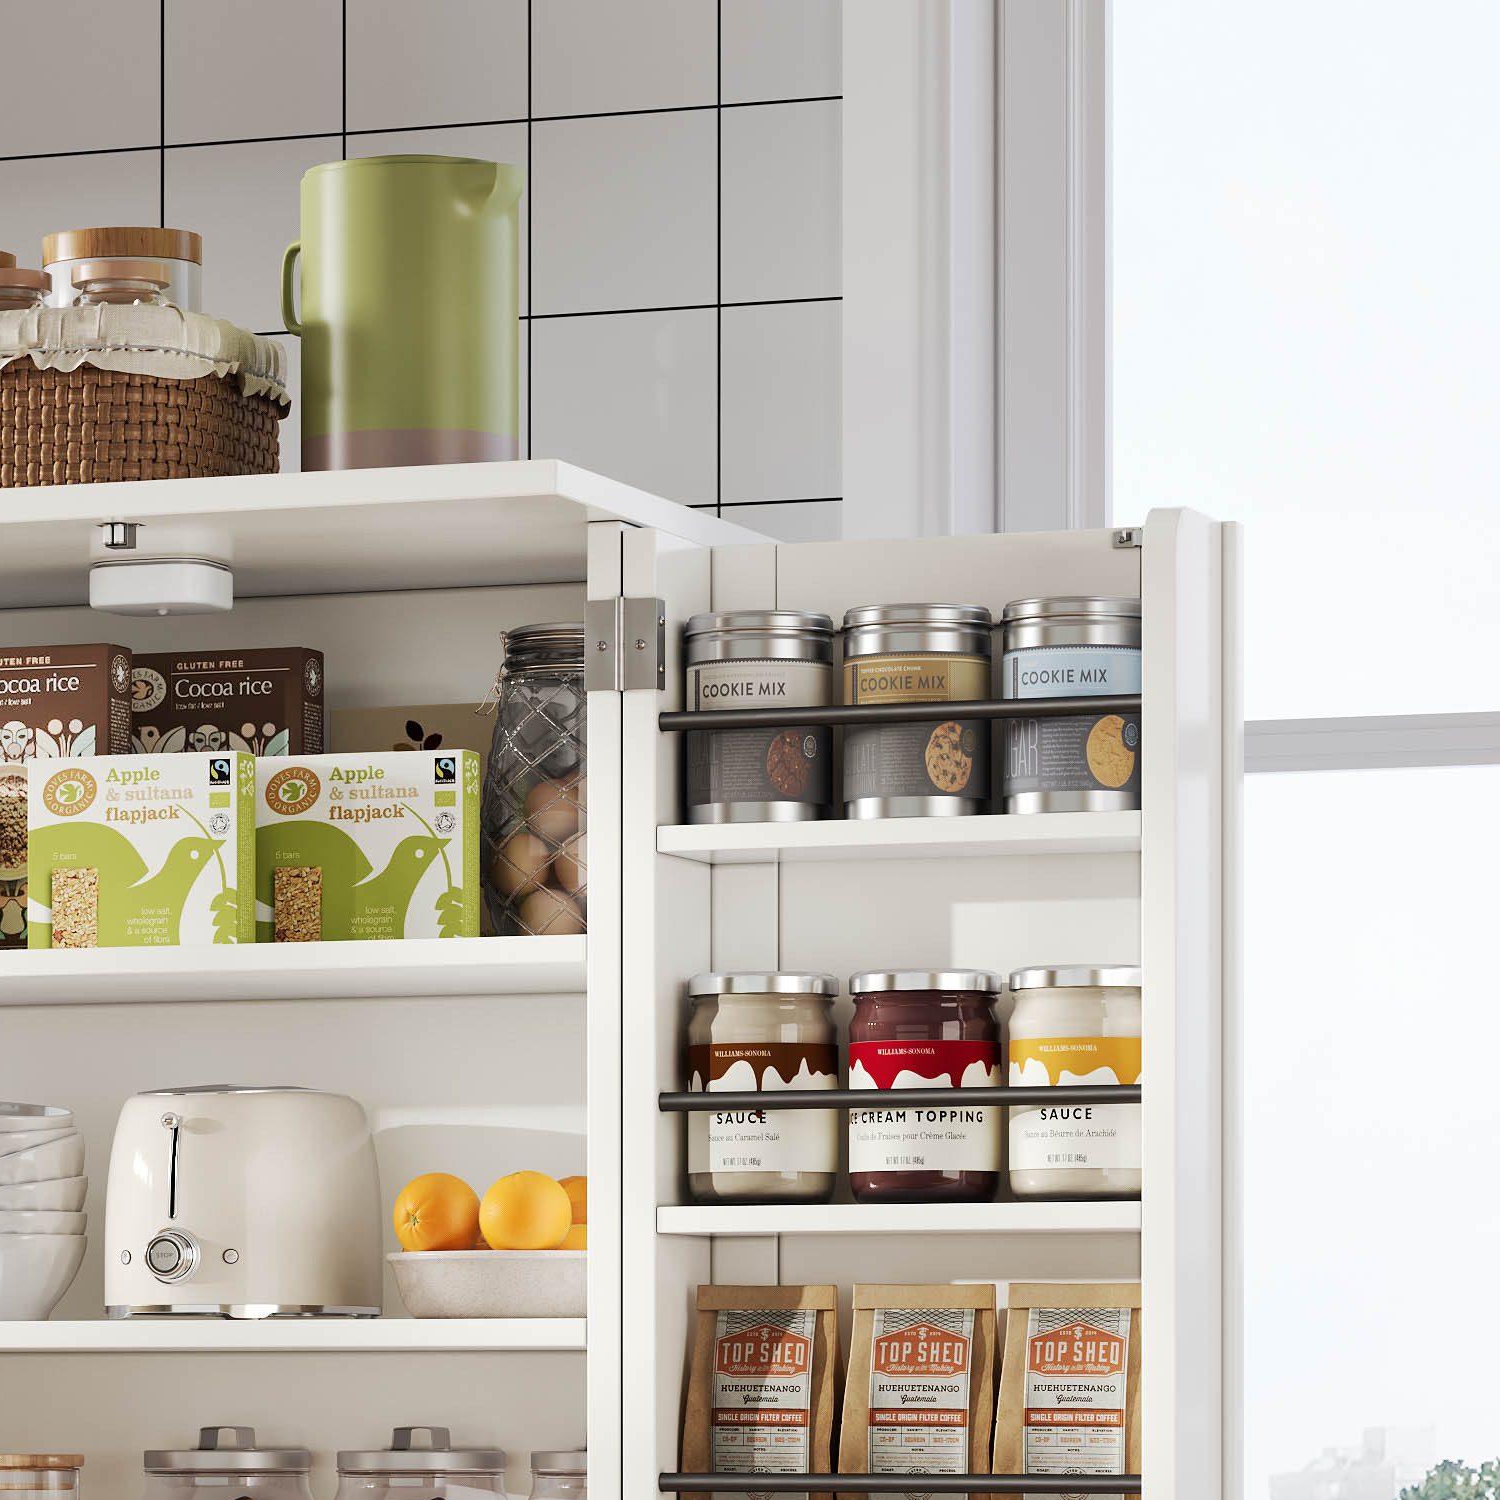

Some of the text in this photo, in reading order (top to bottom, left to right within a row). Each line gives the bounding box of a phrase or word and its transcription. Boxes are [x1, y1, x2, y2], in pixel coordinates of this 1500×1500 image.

[26, 655, 51, 665] FREE
[176, 660, 244, 670] GLUTEN FREE
[45, 673, 80, 692] rice
[860, 675, 946, 693] COOKIE MIX
[1021, 669, 1108, 685] COOKIE MIX
[174, 676, 273, 698] Cocoa rice
[702, 681, 786, 698] COOKIE MIX
[105, 766, 161, 785] Apple
[329, 765, 385, 784] Apple
[106, 785, 194, 801] & sultana
[329, 784, 419, 800] & sultana
[105, 805, 182, 824] flapjack
[329, 805, 405, 824] flapjack
[714, 1050, 772, 1058] WILLIAMS-SONOMA
[877, 1048, 935, 1056] WILLIAMS-SONOMA
[716, 1112, 768, 1125] SAUCE
[861, 1111, 907, 1123] CREAM
[915, 1110, 984, 1123] TOPPING
[1040, 1107, 1093, 1120] SAUCE
[722, 1342, 805, 1365] TOP SHED
[879, 1341, 964, 1364] TOP SHED
[1034, 1340, 1119, 1364] TOP SHED
[720, 1384, 801, 1393] HUEHUETENANGO
[878, 1384, 960, 1393] HUEHUETENANGO
[1033, 1384, 1117, 1393] HUEHUETENANGO
[742, 1394, 779, 1404] Guatemala
[718, 1413, 803, 1423] SINGLE ORIGIN FILTER COFFEE
